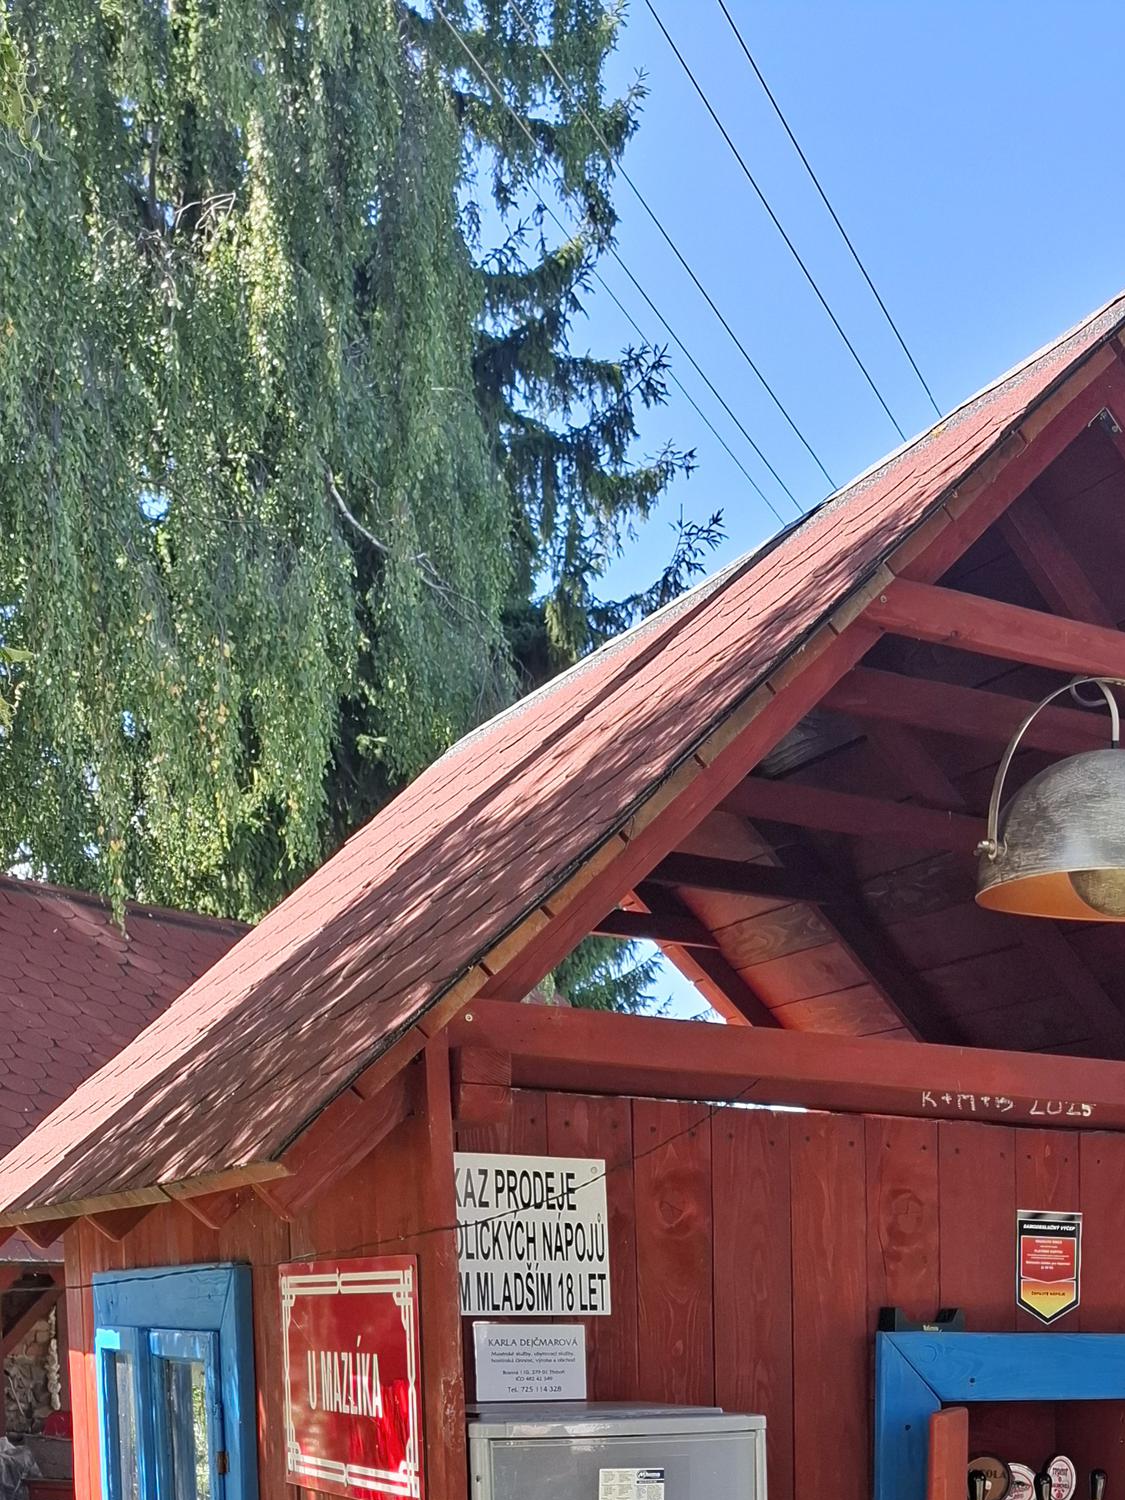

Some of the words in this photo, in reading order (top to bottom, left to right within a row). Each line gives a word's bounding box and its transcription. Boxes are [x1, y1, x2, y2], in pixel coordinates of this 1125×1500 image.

[495, 1169, 577, 1211] PRODEJE
[542, 1211, 605, 1263] NÁPOJŮ
[476, 1262, 553, 1312] MLADŠÍM
[557, 1272, 575, 1312] 18
[579, 1273, 607, 1312] LET
[488, 1338, 517, 1347] KARLA
[519, 1336, 578, 1348] DEJČMAROVÁ
[307, 1350, 318, 1411] U
[320, 1335, 383, 1418] MAZLÍKA
